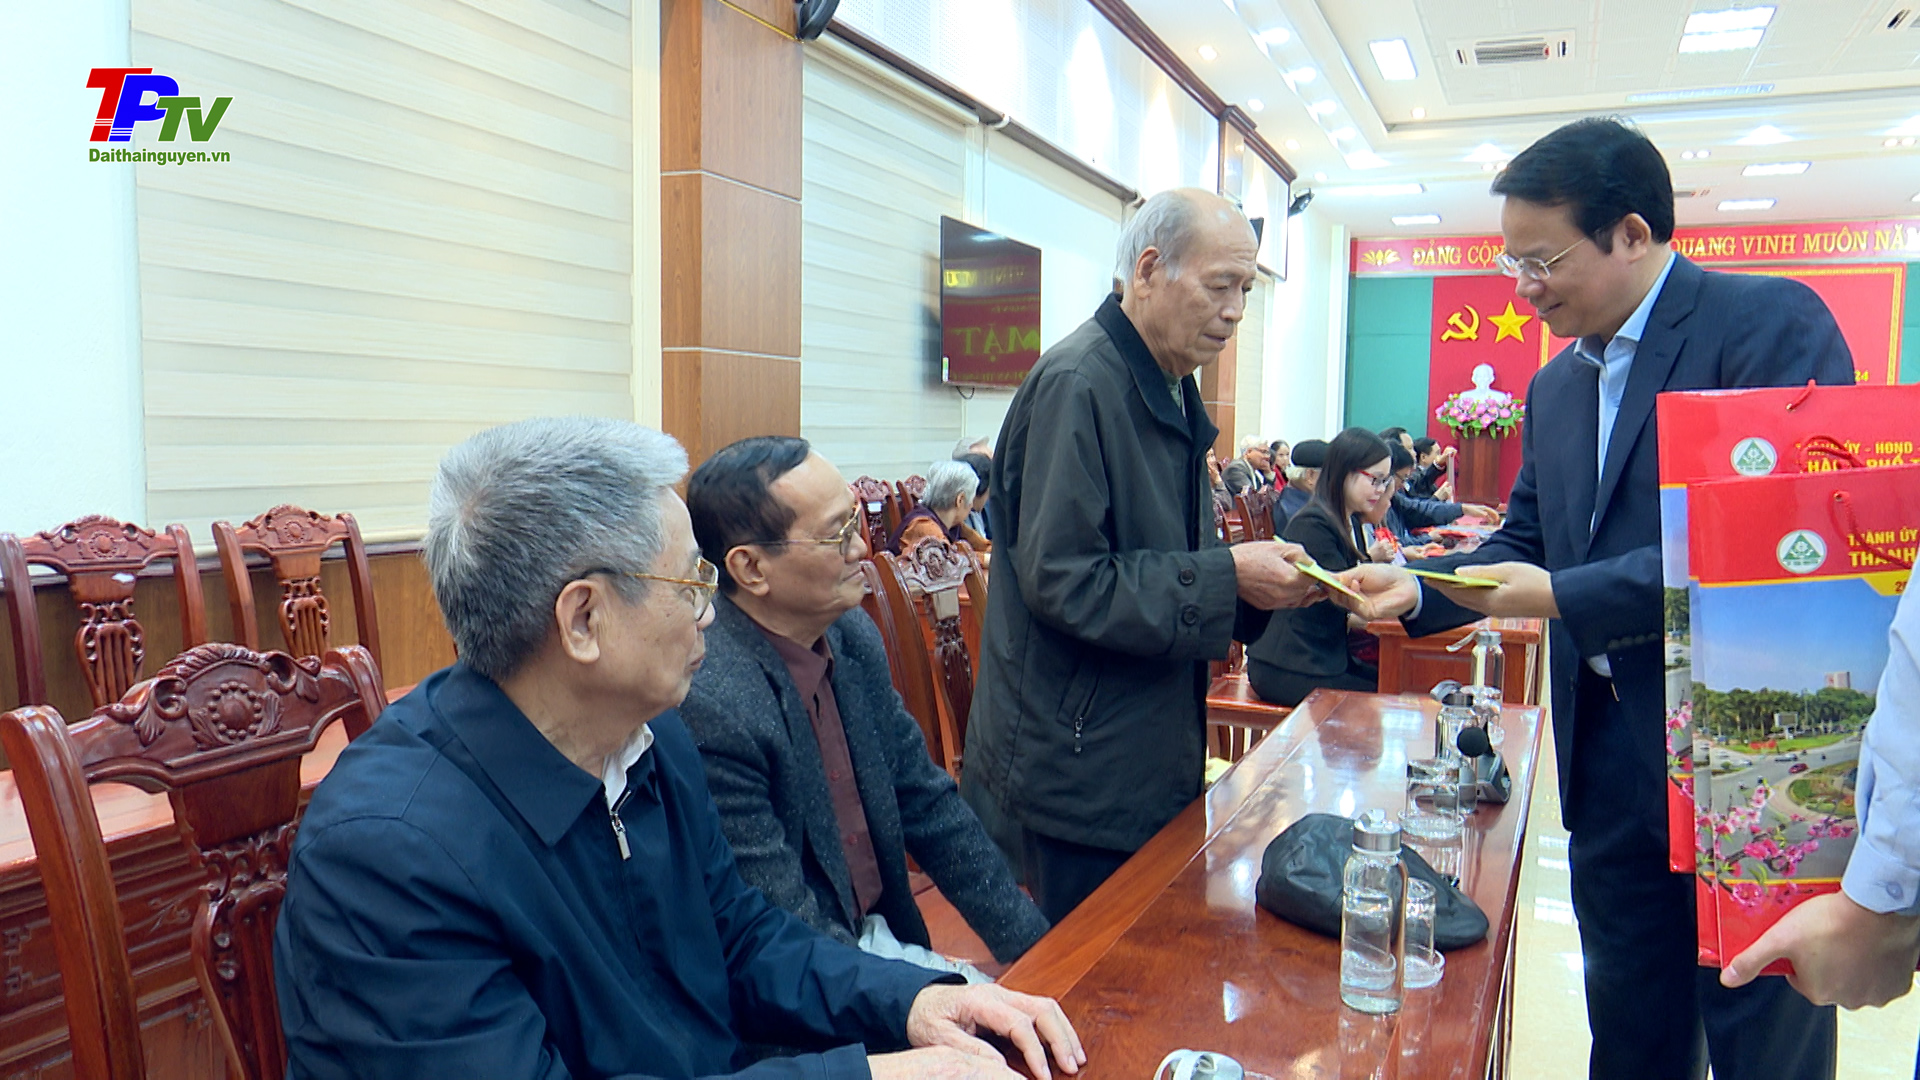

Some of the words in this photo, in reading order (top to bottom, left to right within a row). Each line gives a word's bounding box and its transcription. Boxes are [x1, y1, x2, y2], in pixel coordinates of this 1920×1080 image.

[1412, 240, 1462, 265] ĐẢNG
[1467, 240, 1505, 267] CỘN
[1670, 236, 1737, 257] QUANG
[1741, 234, 1797, 255] VINH
[1802, 225, 1868, 254] MUÔN
